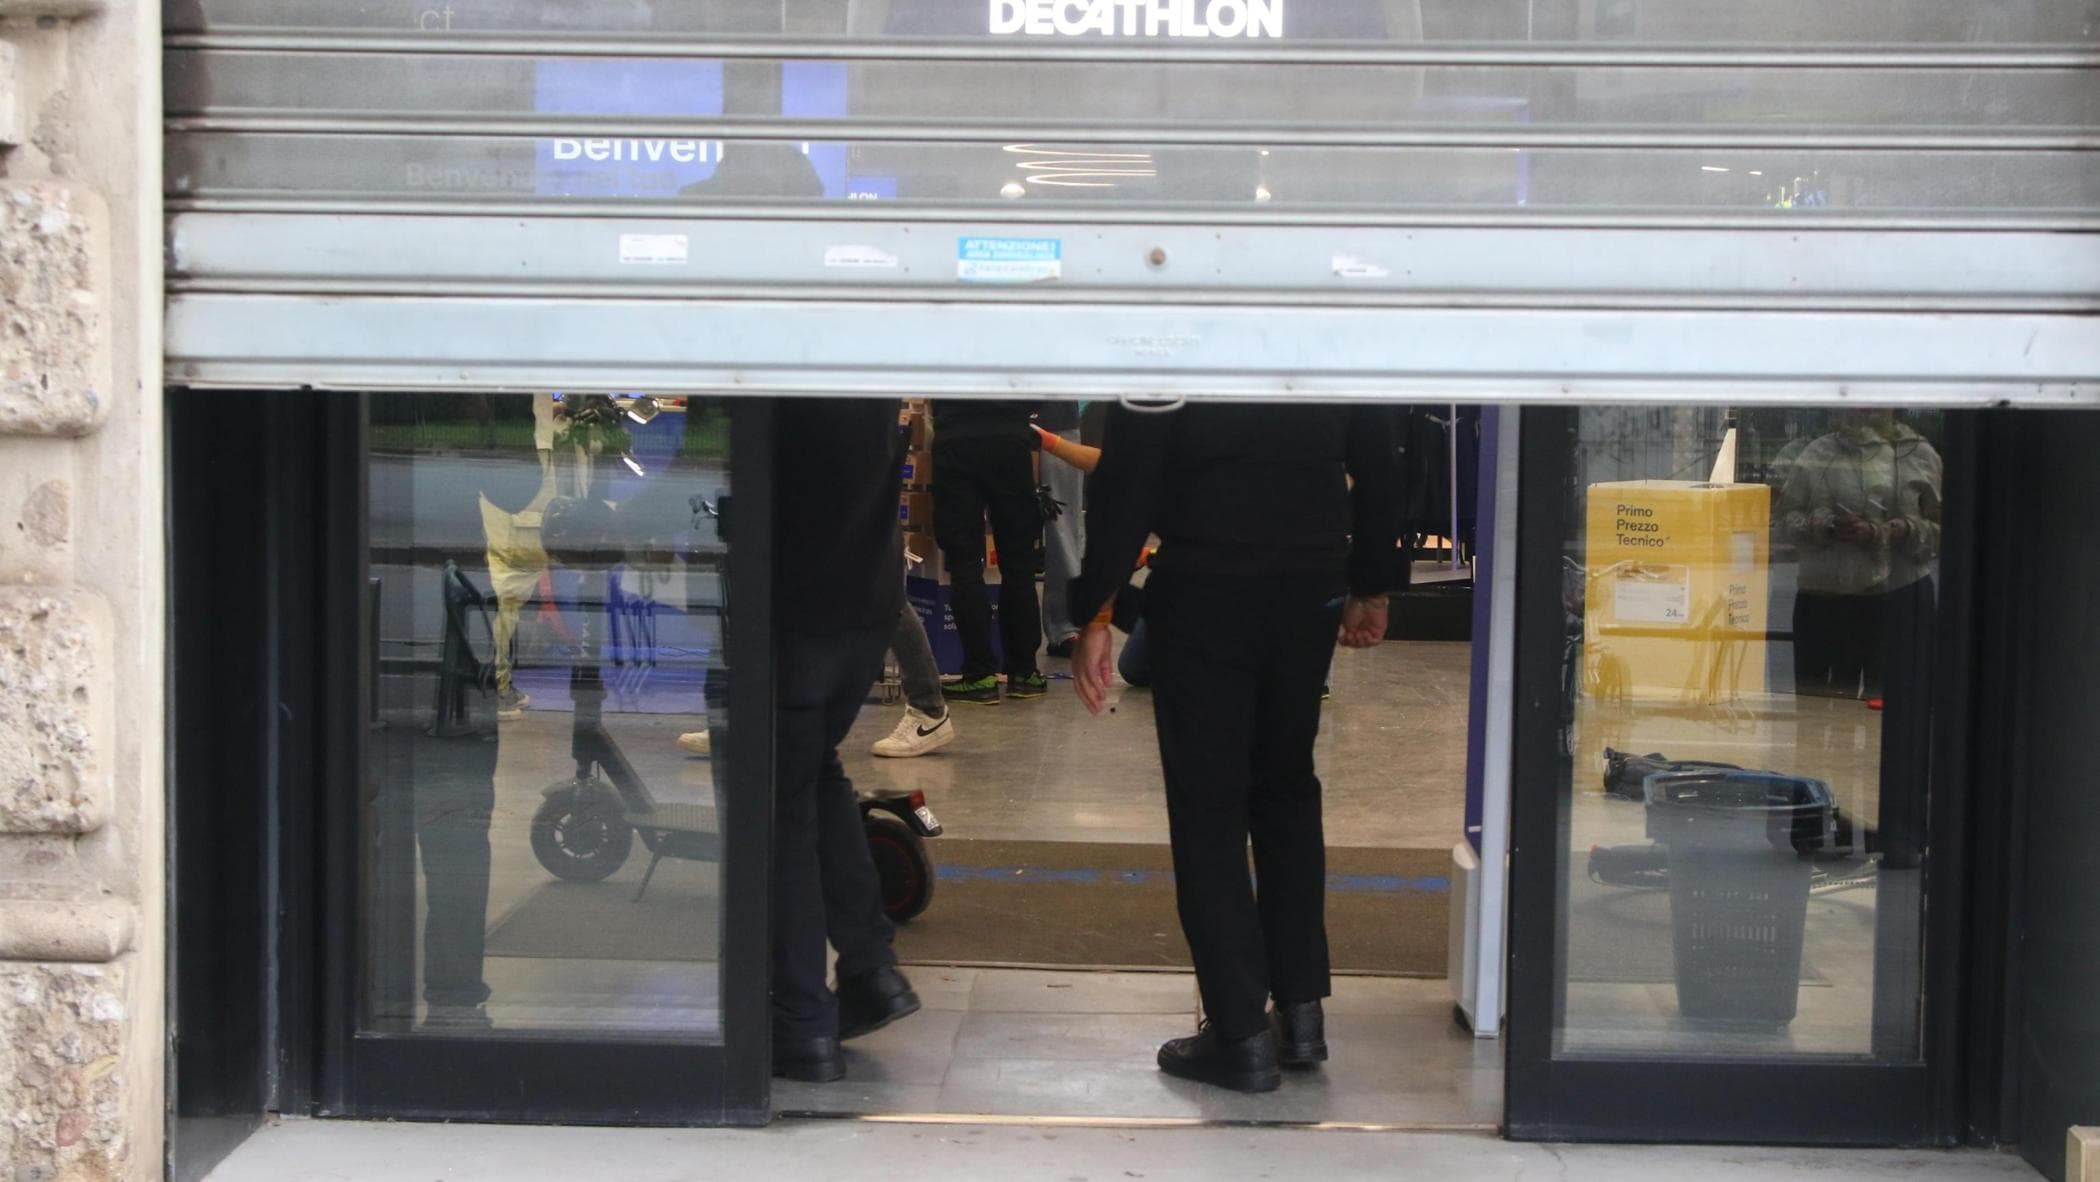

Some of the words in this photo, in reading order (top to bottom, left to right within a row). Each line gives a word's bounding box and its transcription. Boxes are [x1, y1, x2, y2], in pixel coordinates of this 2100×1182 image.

[989, 0, 1284, 37] DECATHLON
[1616, 504, 1653, 518] Primo
[1616, 519, 1659, 532] Prezzo
[1616, 533, 1664, 547] Tecnico
